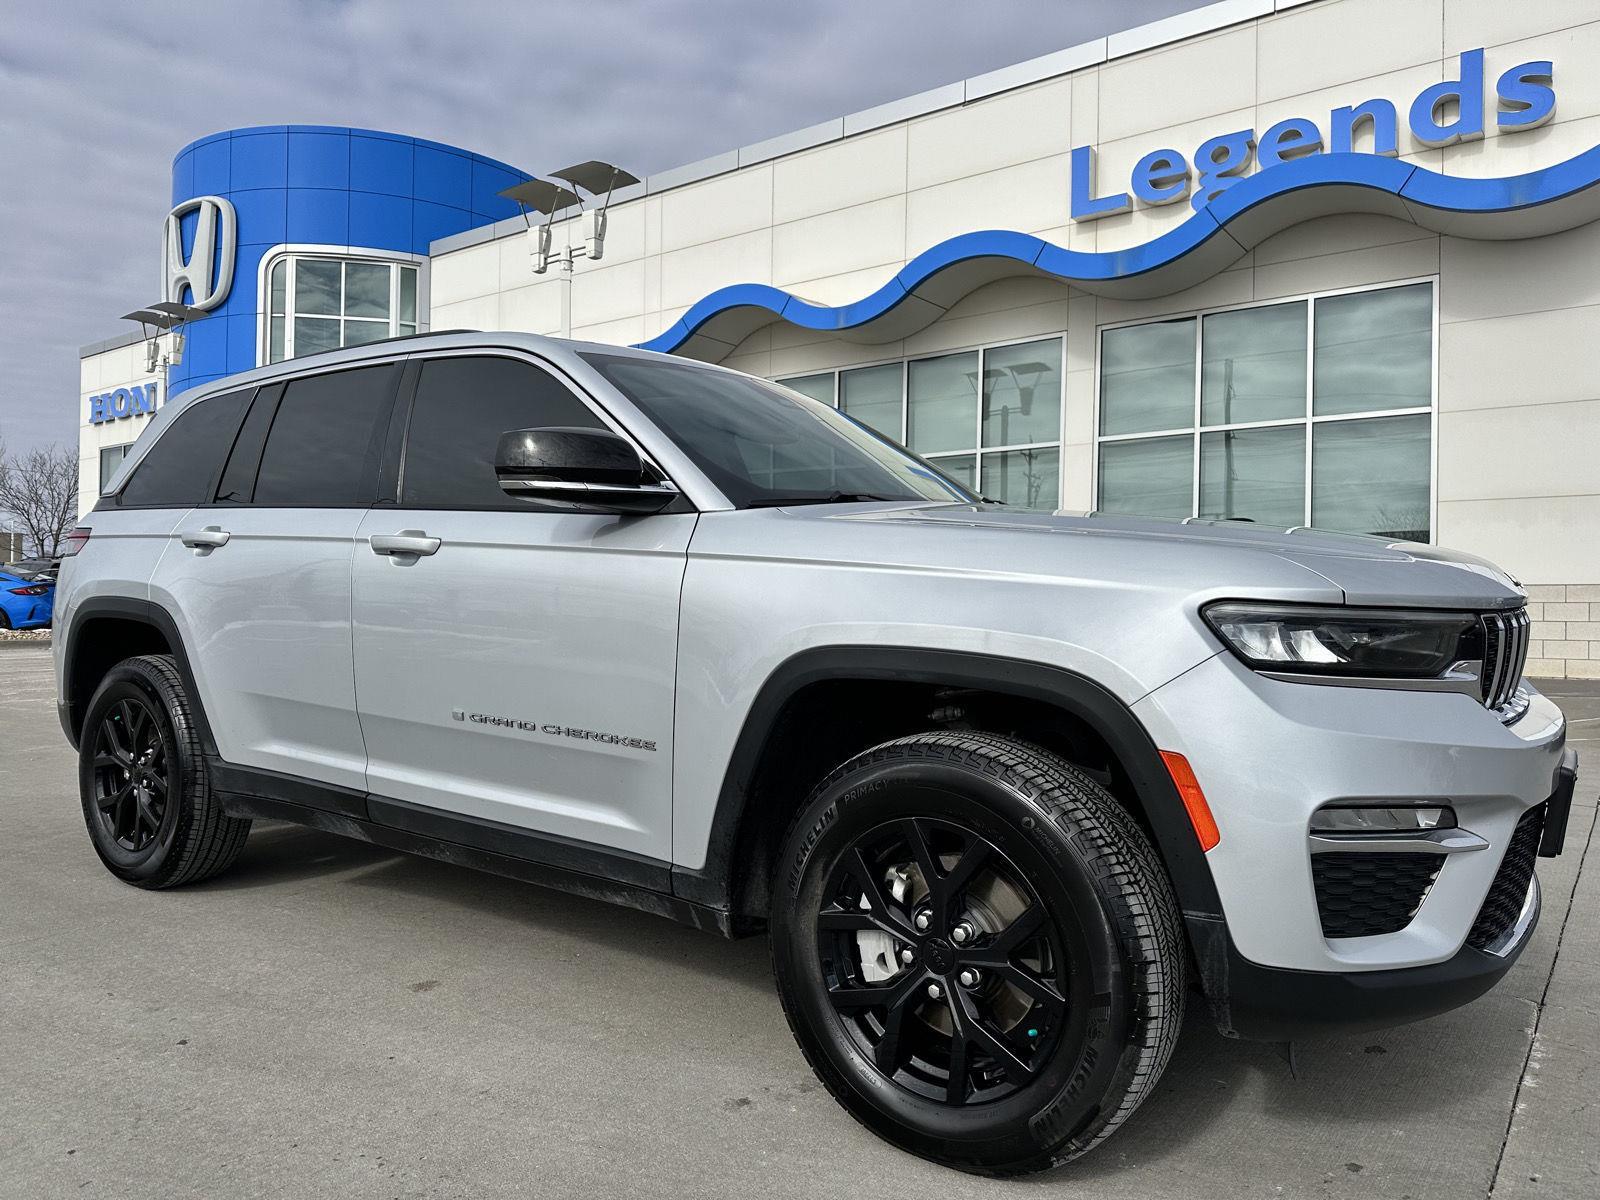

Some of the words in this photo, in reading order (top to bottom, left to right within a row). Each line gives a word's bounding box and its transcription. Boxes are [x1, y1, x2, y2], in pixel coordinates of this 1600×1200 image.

[1071, 47, 1556, 221] Legends
[469, 713, 536, 731] GRAND
[541, 725, 656, 751] CHEROKEE
[844, 779, 888, 804] PRIMACY
[788, 807, 834, 891] MICHELIN
